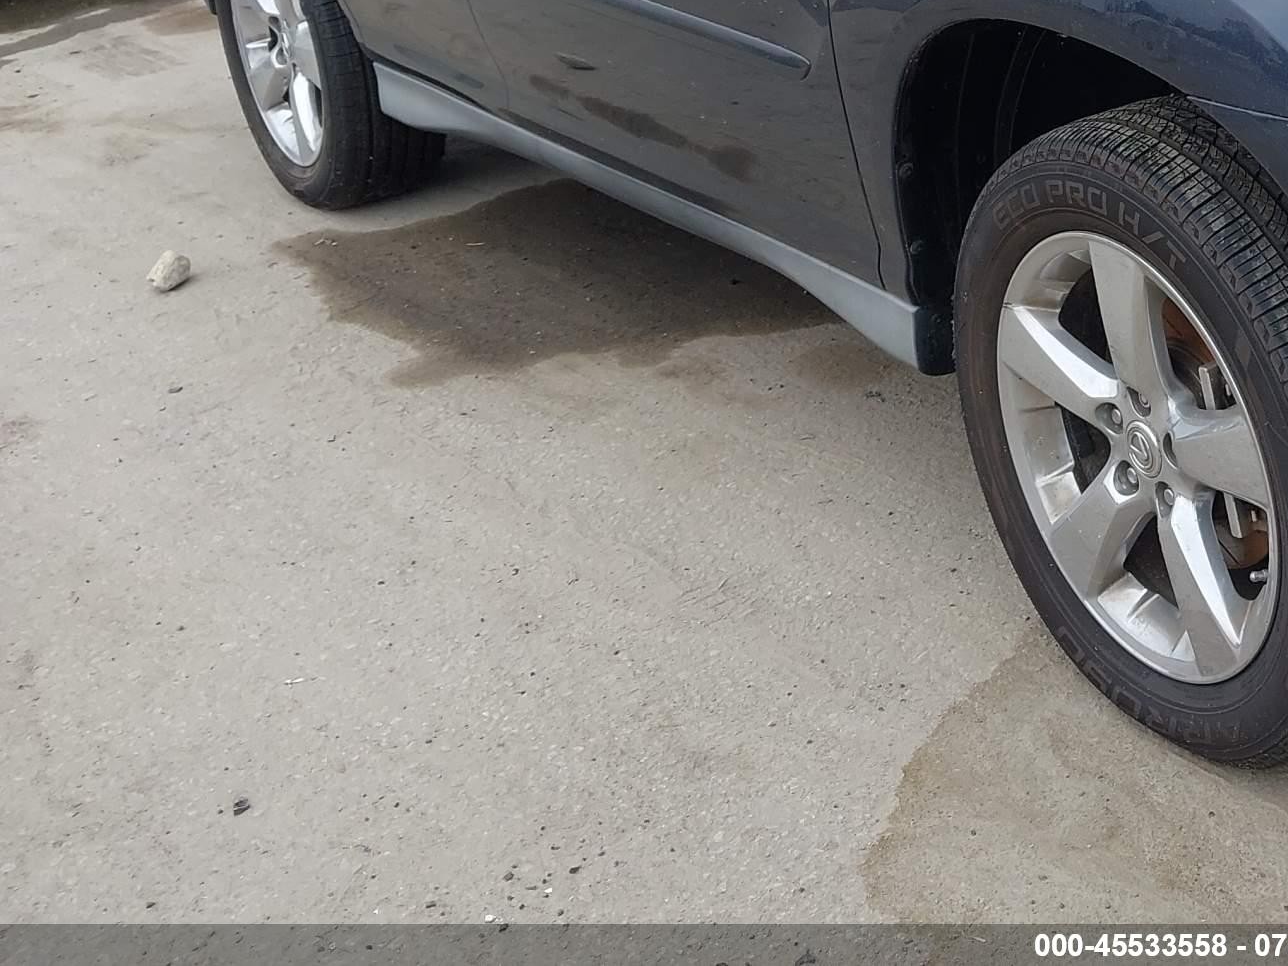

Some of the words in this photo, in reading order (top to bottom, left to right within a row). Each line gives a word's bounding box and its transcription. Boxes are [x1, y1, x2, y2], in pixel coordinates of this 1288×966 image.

[992, 183, 1040, 231] ECO
[1045, 179, 1107, 216] PRO
[1119, 201, 1187, 270] H/T
